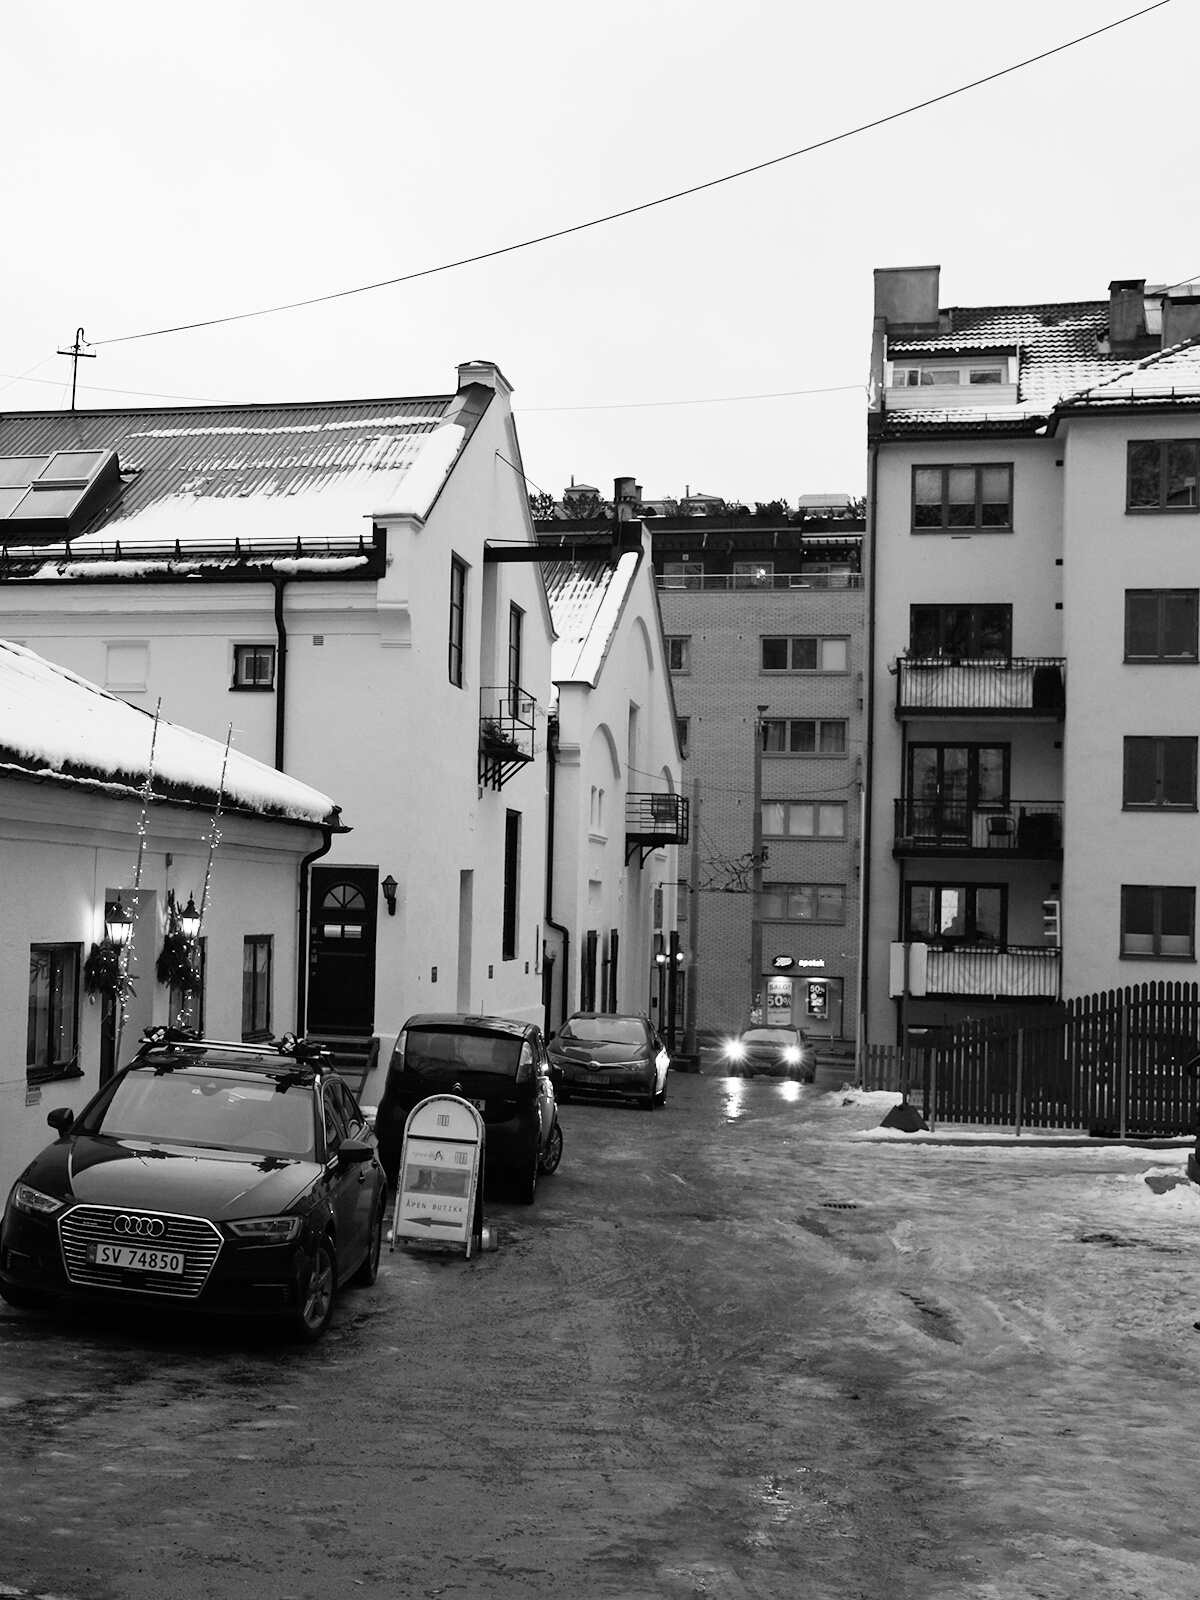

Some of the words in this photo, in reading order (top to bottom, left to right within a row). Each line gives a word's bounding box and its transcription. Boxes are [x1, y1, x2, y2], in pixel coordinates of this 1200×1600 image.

[768, 995, 791, 1007] 50%
[405, 1199, 427, 1209] ÅPEN
[432, 1203, 463, 1213] BUTIKK
[101, 1246, 122, 1263] SV
[128, 1249, 180, 1271] 74850
